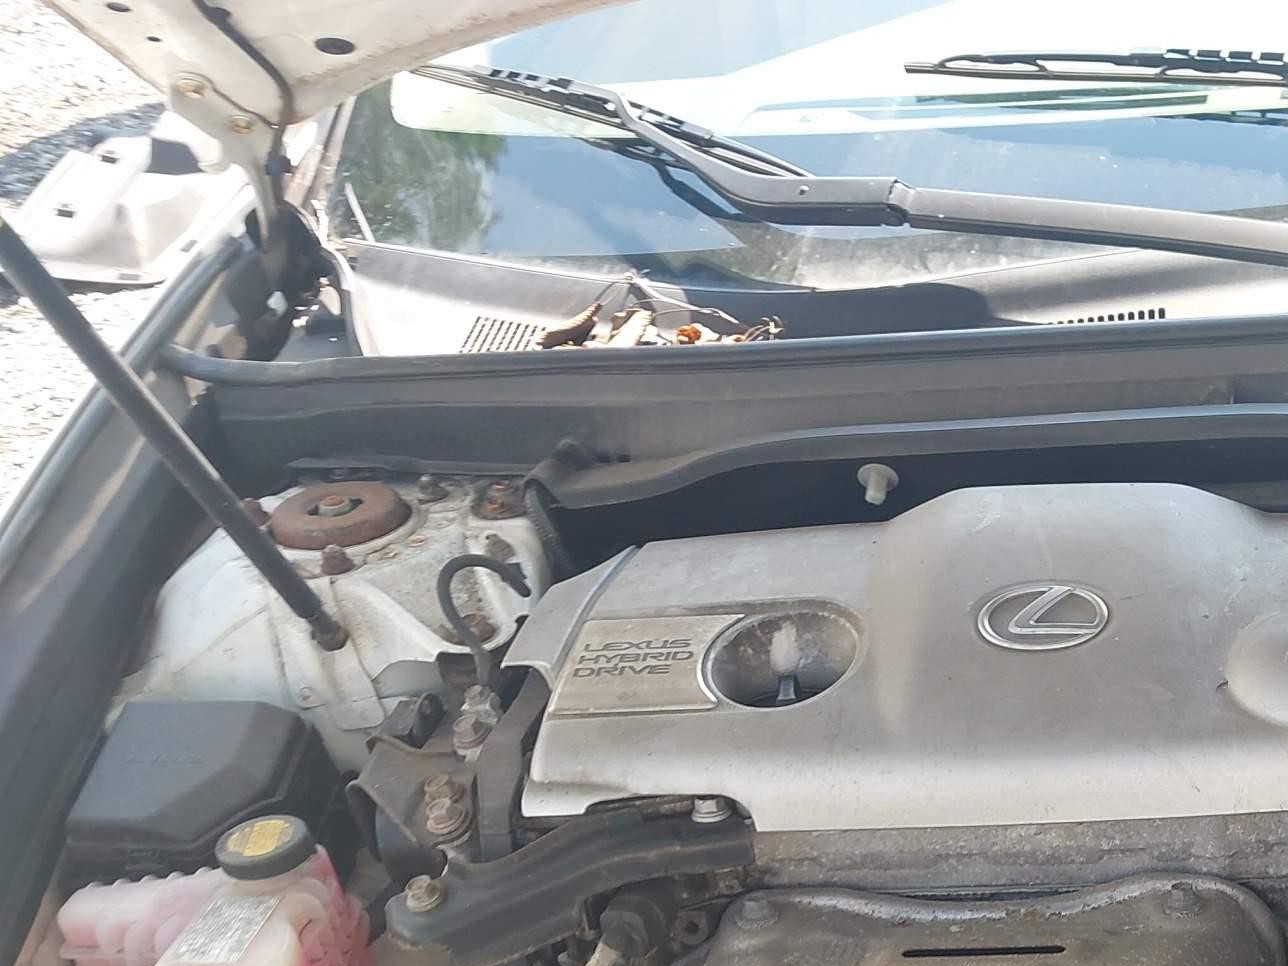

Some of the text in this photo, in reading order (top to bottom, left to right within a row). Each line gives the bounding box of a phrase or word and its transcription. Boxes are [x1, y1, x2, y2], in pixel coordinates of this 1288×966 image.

[584, 639, 693, 652] LEXUS
[578, 651, 694, 664] HYBRID
[573, 664, 672, 678] DRIVE
